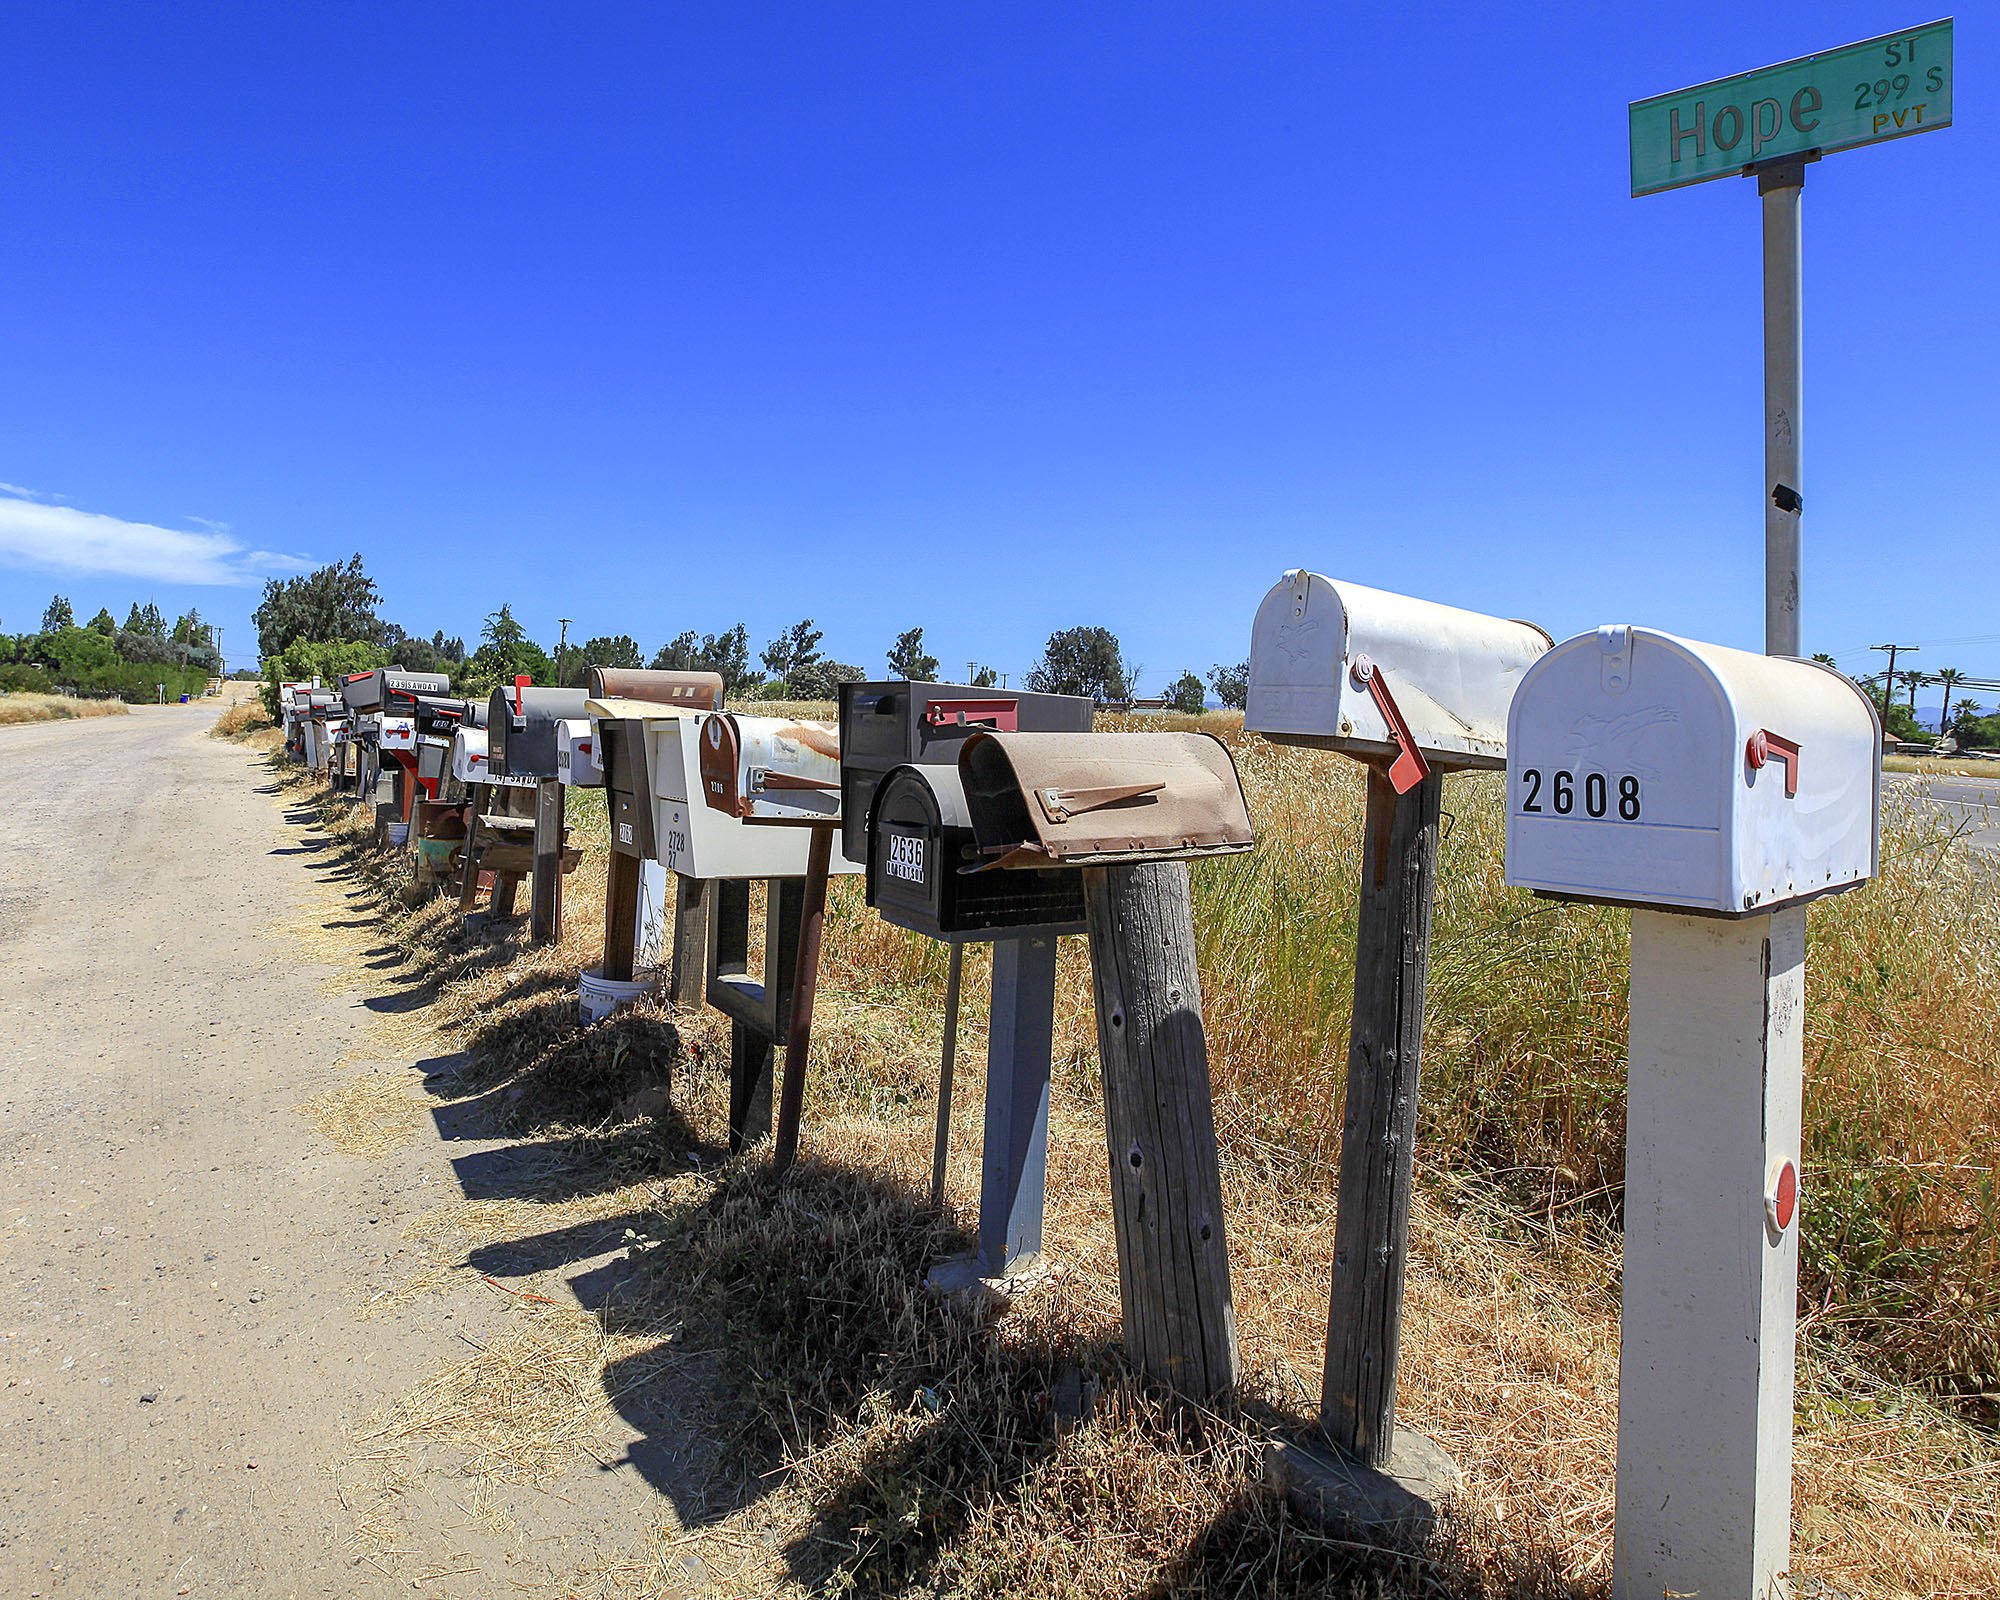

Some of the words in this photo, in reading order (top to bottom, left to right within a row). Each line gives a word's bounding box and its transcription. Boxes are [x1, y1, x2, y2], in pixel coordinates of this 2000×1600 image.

[1884, 36, 1920, 68] ST
[1854, 74, 1910, 111] 299
[1926, 66, 1943, 93] S
[1669, 85, 1823, 163] Hope
[1873, 104, 1928, 134] PVT
[1522, 768, 1641, 821] 2608
[668, 830, 685, 853] 2728
[891, 835, 922, 867] 2636
